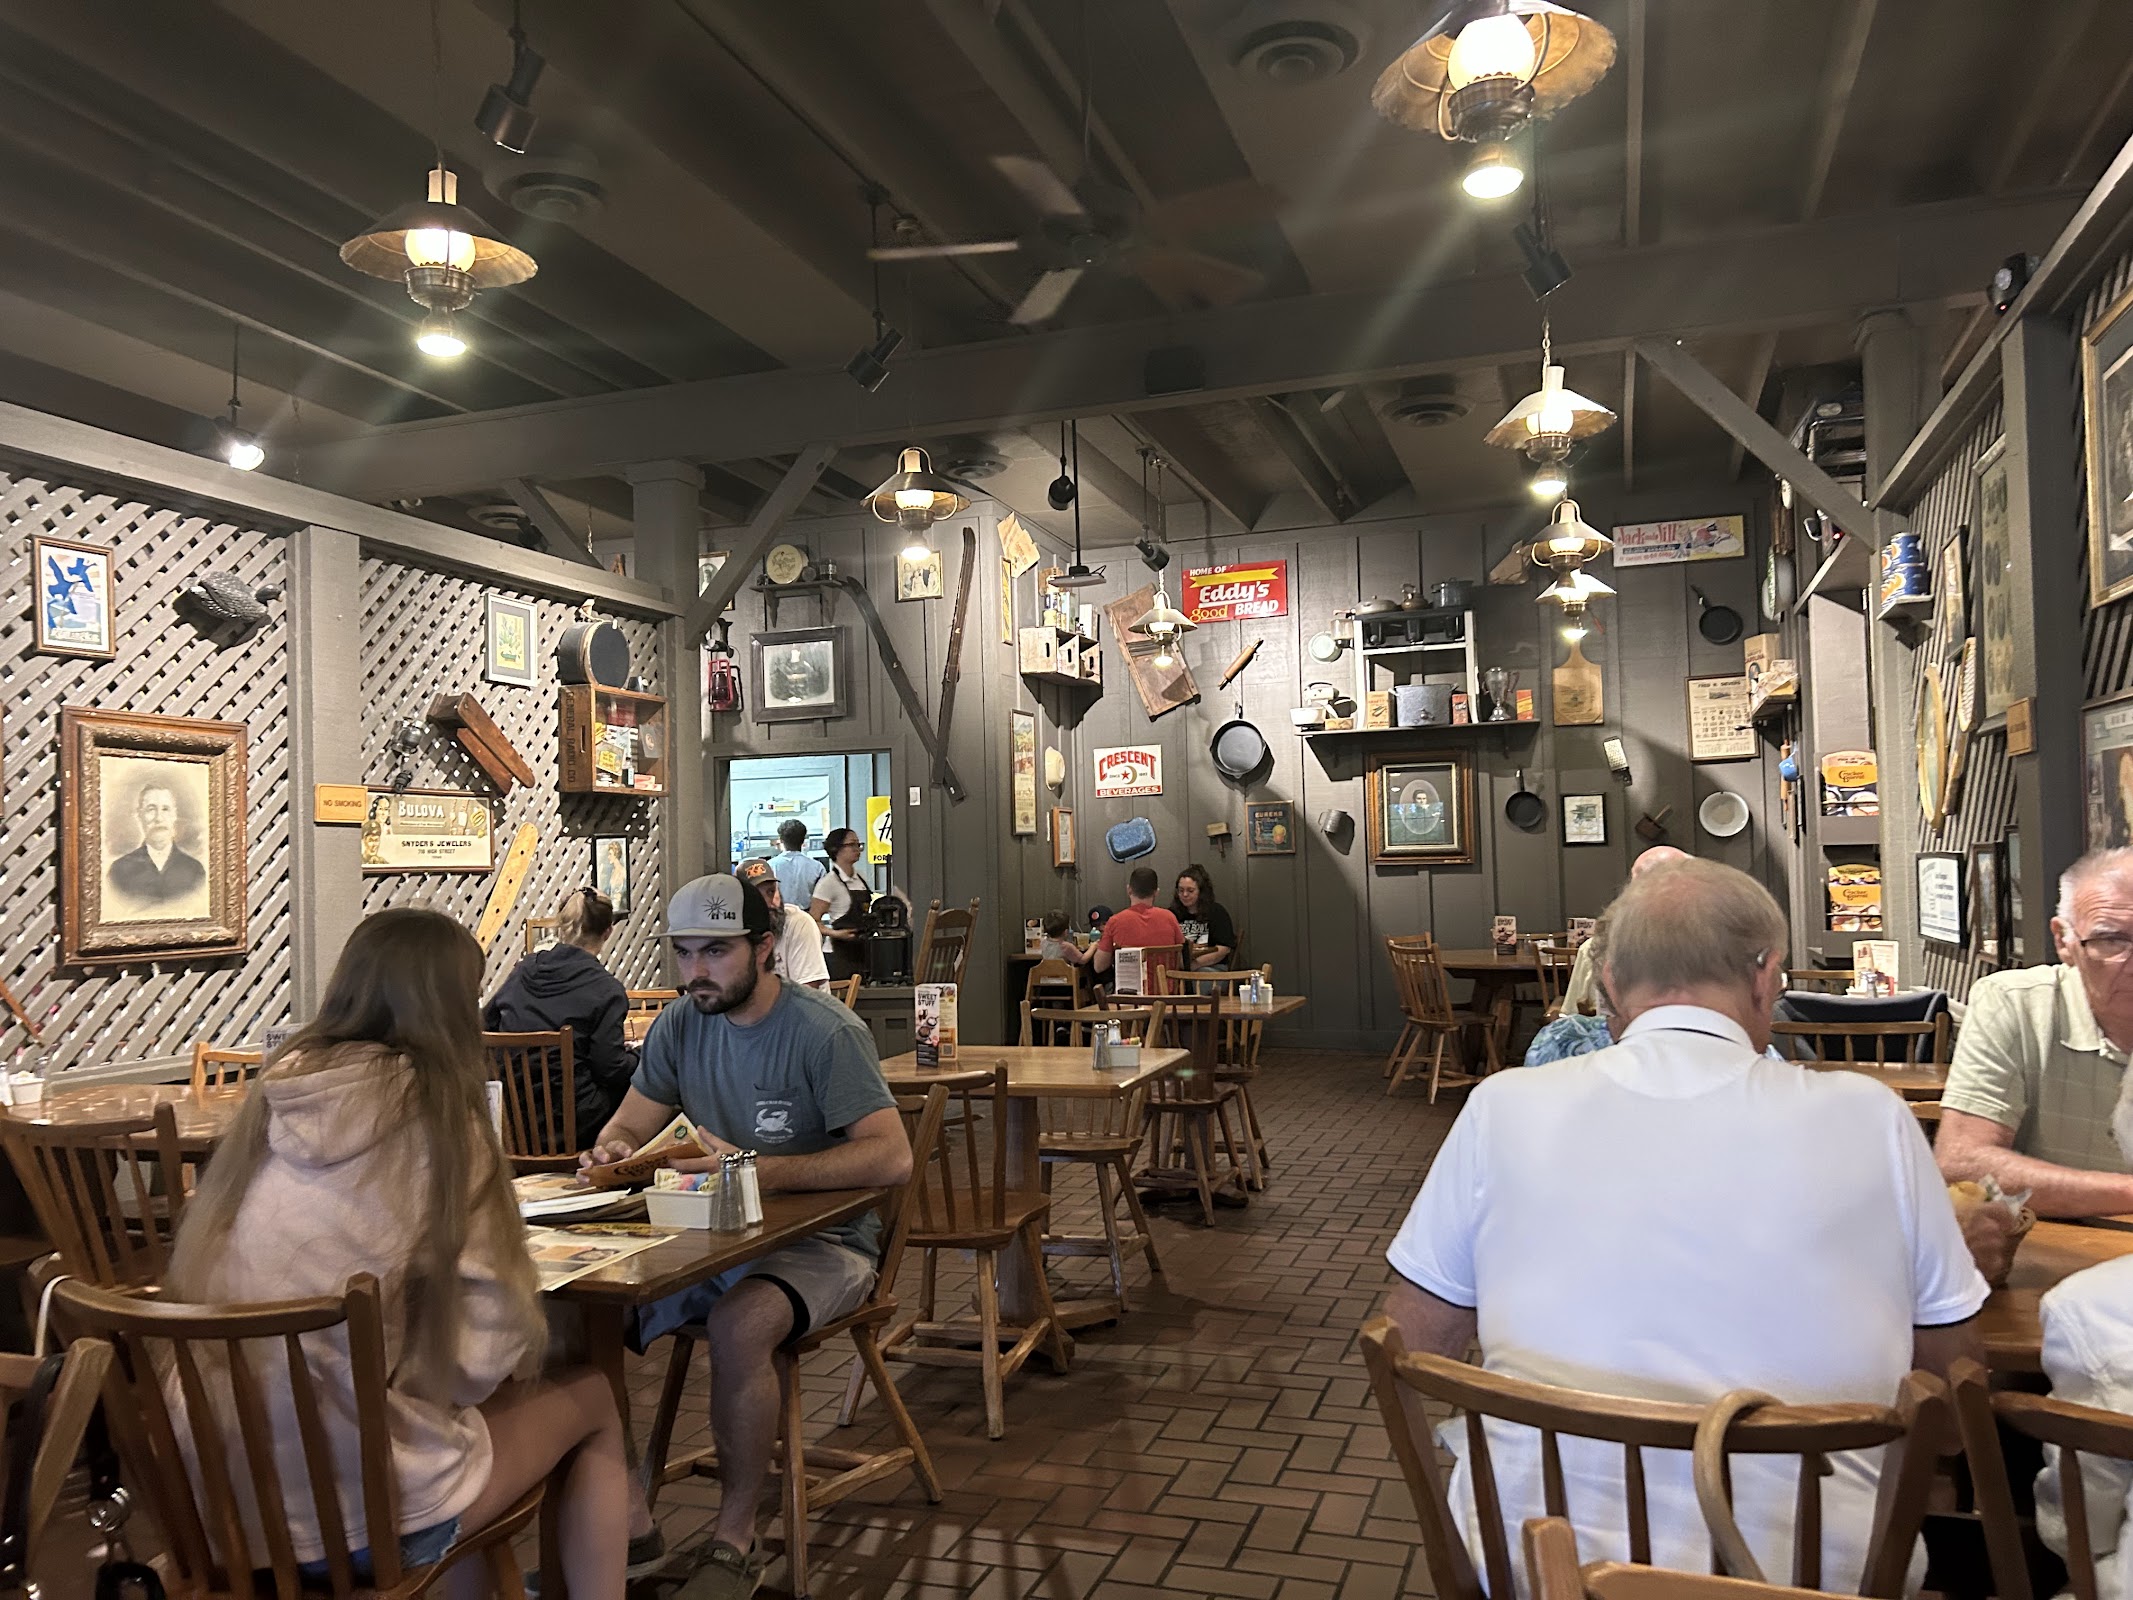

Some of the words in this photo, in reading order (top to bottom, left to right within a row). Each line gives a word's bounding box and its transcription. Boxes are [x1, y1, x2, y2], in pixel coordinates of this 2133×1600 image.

[1189, 567, 1212, 577] HOME
[1214, 565, 1227, 574] OF
[1199, 580, 1270, 606] Eddy's
[1189, 604, 1228, 623] good
[1234, 599, 1279, 616] BREAD
[566, 691, 576, 734] GENERAL
[566, 737, 576, 766] RADIO
[1098, 750, 1157, 781] CRESCENT
[1100, 786, 1159, 796] BEVERAGES
[323, 799, 332, 807] NO
[334, 800, 362, 808] SMOKING
[398, 801, 446, 819] BULOVA
[723, 911, 736, 920] 143
[917, 992, 937, 1001] SWEET
